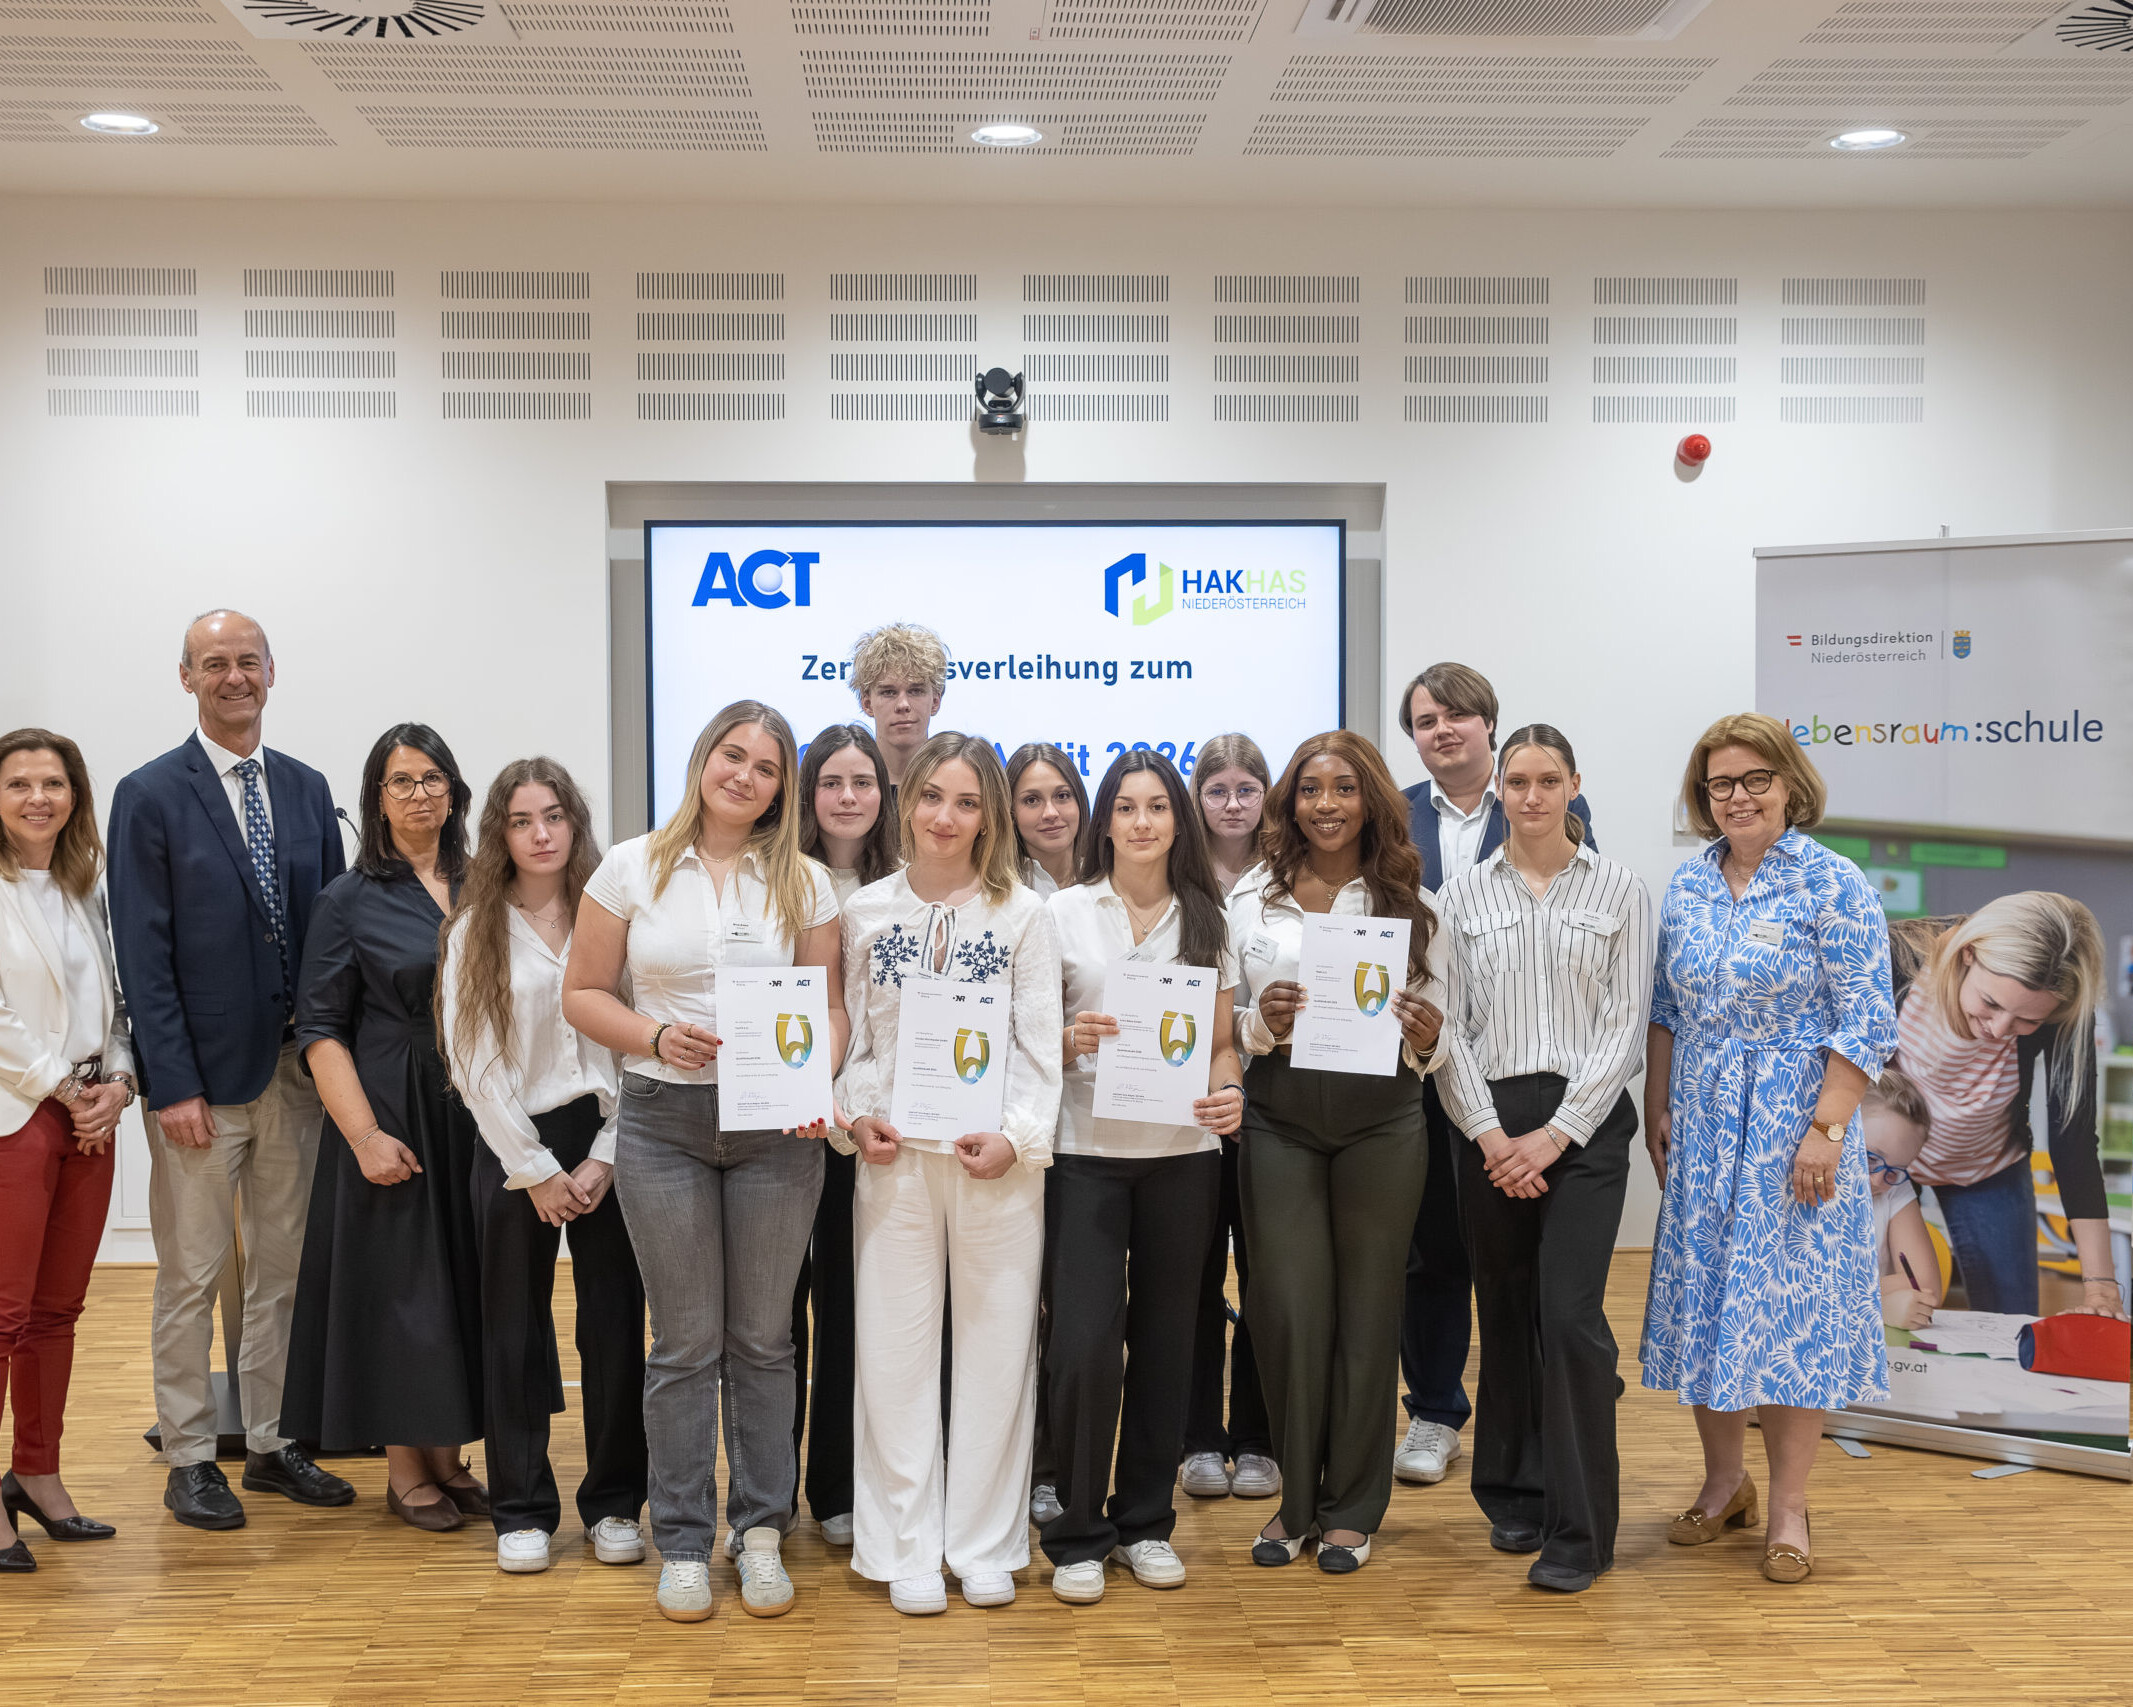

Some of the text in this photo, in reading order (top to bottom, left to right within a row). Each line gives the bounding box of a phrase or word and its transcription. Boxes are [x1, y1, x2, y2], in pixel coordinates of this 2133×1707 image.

[691, 549, 820, 610] ACT
[1182, 569, 1307, 594] HAKHAS
[1182, 596, 1307, 610] NIEDERÖSTERREICH
[1811, 630, 1933, 648] Bildungsdirektion
[1811, 649, 1927, 664] Niederösterreich
[801, 654, 1192, 686] Zersverleihung zum
[1379, 930, 1395, 938] ACT
[796, 979, 811, 987] ACT
[1186, 979, 1202, 987] ACT
[979, 996, 994, 1005] ACT
